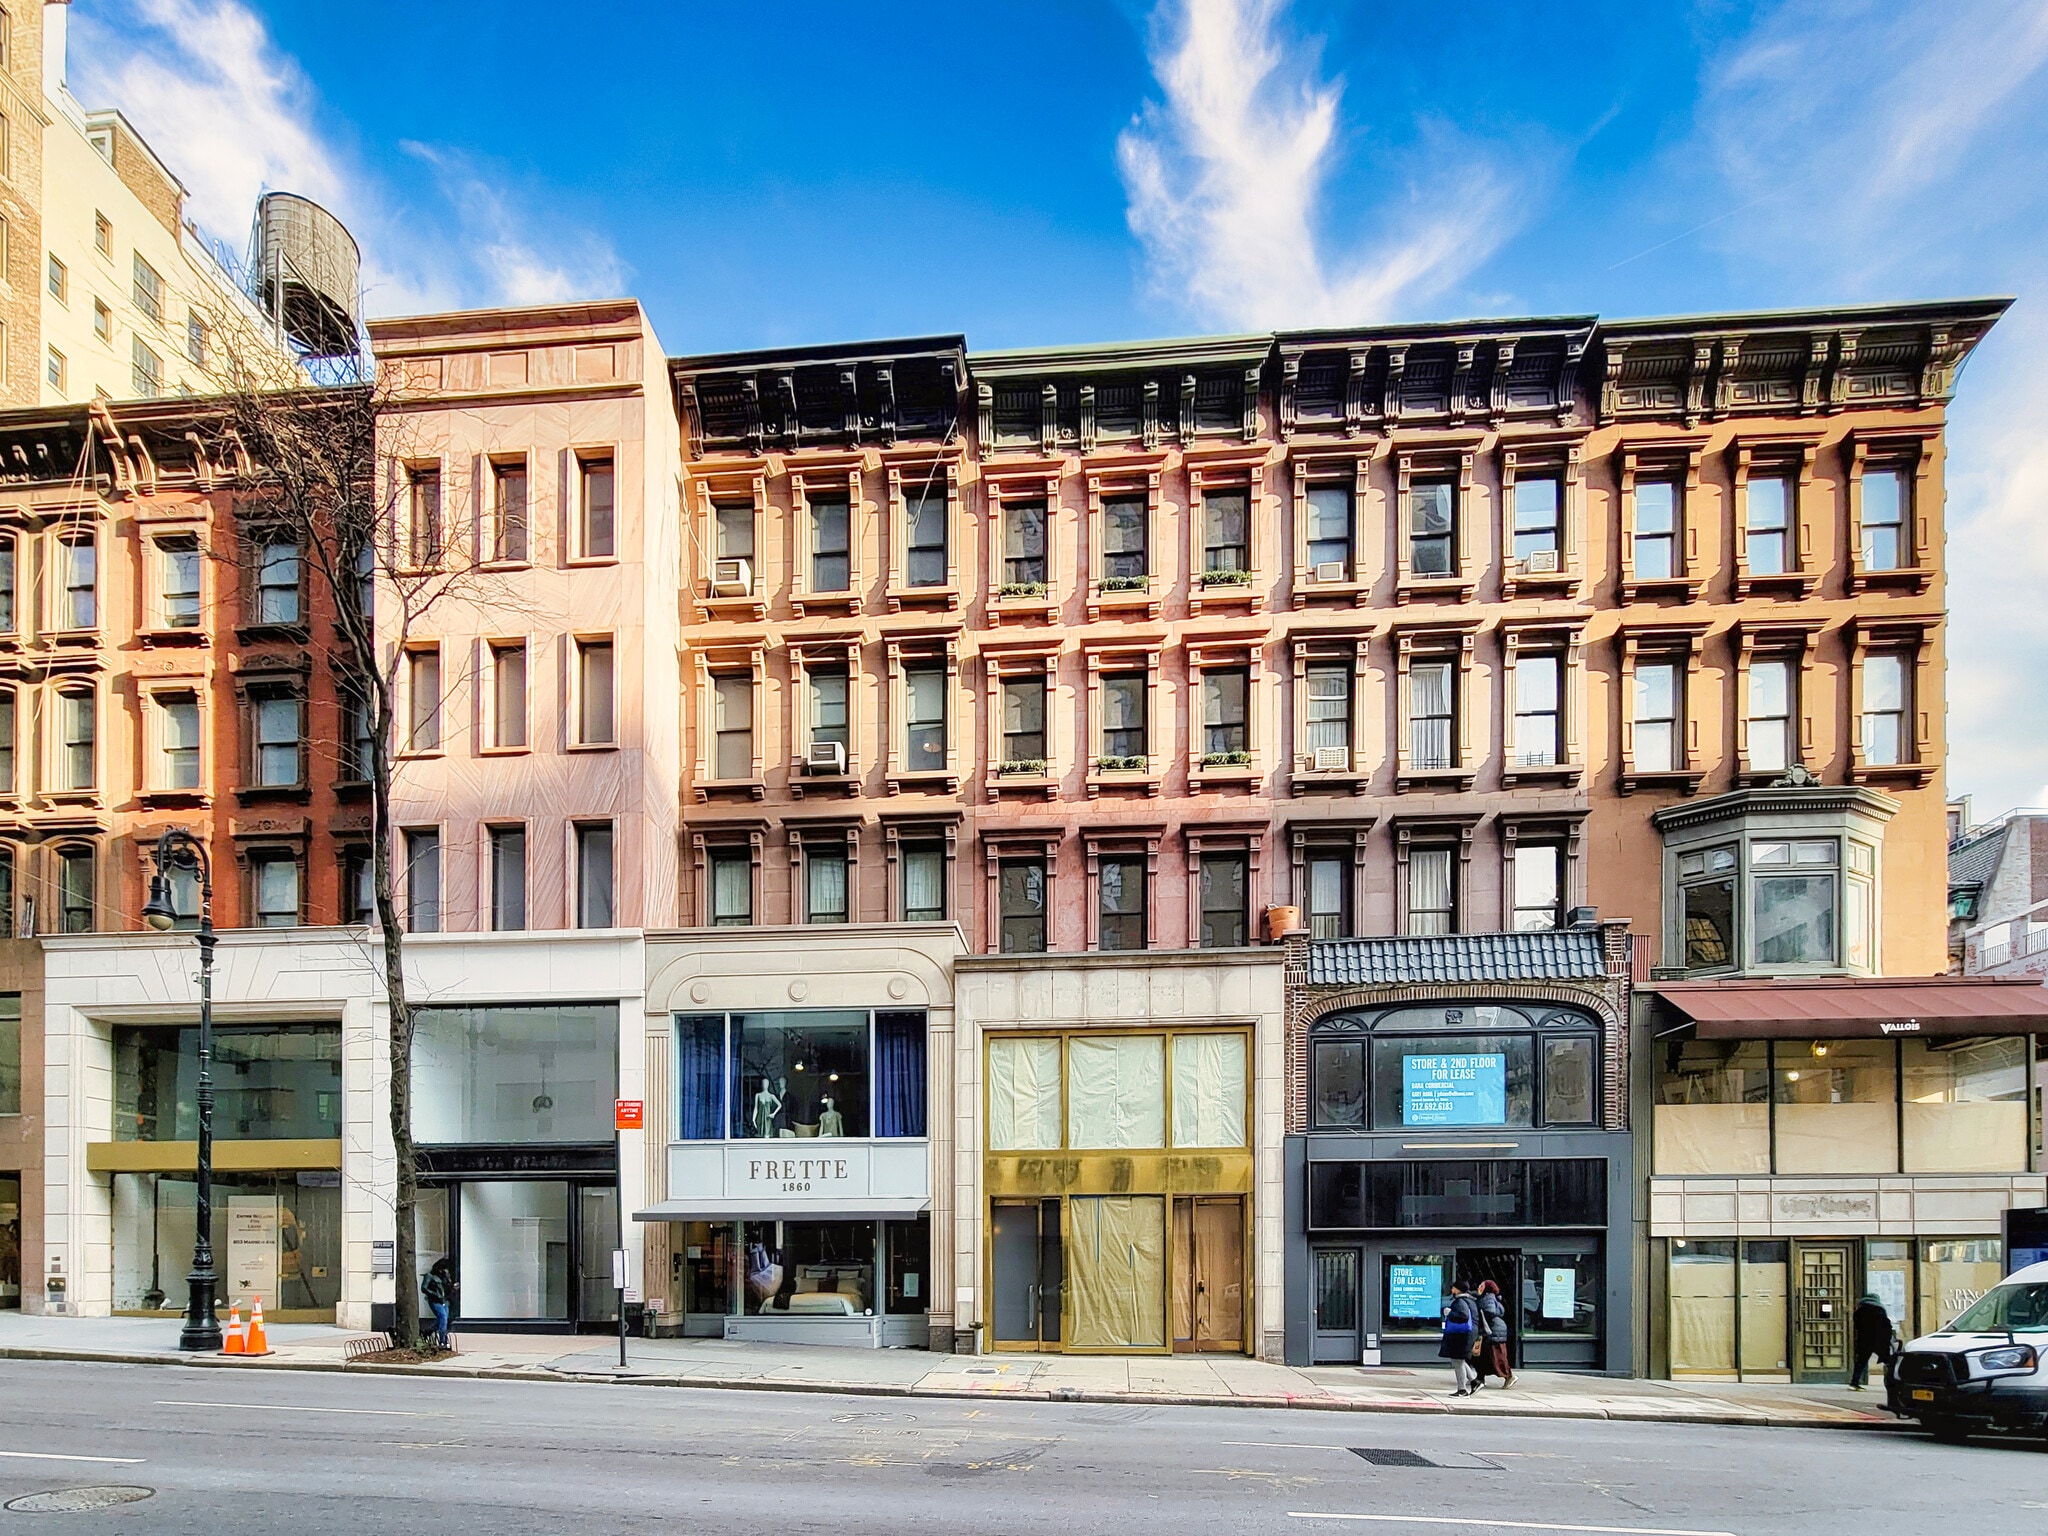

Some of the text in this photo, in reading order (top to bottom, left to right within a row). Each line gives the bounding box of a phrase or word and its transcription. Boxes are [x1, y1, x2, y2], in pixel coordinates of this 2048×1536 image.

[1411, 1057, 1496, 1069] STORE & 2ND FLOOR
[1432, 1069, 1476, 1080] FOR LEASE
[1411, 1102, 1453, 1111] 212.692.6183
[749, 1160, 848, 1179] FRETTE
[782, 1182, 811, 1192] 1860
[1393, 1268, 1413, 1276] STORE
[1407, 1277, 1426, 1285] LEASE
